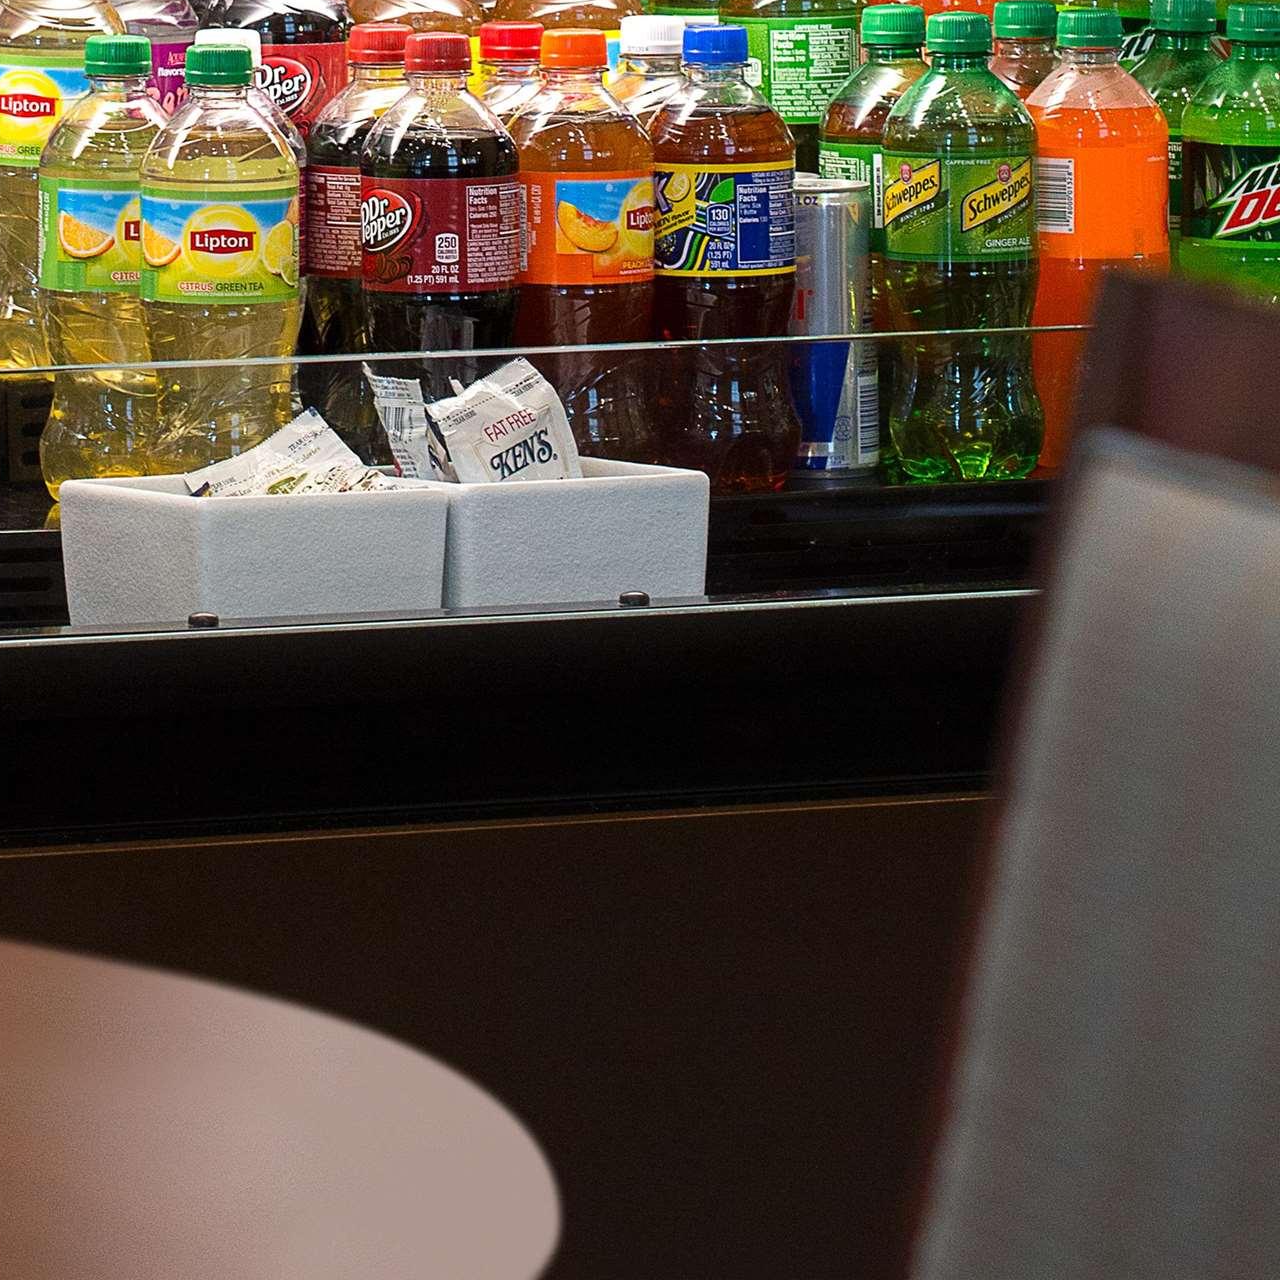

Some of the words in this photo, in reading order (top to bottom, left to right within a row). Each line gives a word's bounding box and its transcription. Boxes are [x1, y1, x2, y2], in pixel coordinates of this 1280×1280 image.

[157, 67, 185, 78] flavors
[256, 63, 286, 90] Dr
[0, 97, 51, 114] Lipton
[17, 146, 41, 155] GREE
[469, 187, 498, 196] Nutrition
[885, 175, 938, 218] Schweppes
[469, 196, 488, 205] Facts
[739, 195, 758, 203] Facts
[804, 196, 819, 206] OZ
[968, 174, 1031, 222] Schweppes
[368, 197, 390, 219] Dr
[711, 209, 729, 221] 130
[195, 233, 248, 251] Lipton
[437, 236, 457, 249] 250
[709, 242, 718, 250] 20
[718, 242, 724, 250] FL
[985, 238, 1017, 248] GINGER
[1017, 237, 1031, 246] ALE
[707, 251, 722, 260] (1.25
[722, 251, 733, 260] PT)
[431, 265, 441, 274] 20
[441, 265, 451, 274] FL
[451, 265, 459, 274] OZ
[710, 260, 721, 269] 591
[407, 275, 424, 285] (1.25
[424, 275, 435, 285] PT)
[435, 275, 448, 284] 591
[448, 275, 460, 284] mL
[178, 281, 214, 291] CITRUS
[215, 282, 245, 291] GREEN
[248, 283, 264, 291] TEA
[484, 421, 509, 443] FAT
[508, 407, 537, 432] FREE
[490, 426, 554, 481] KEN'S
